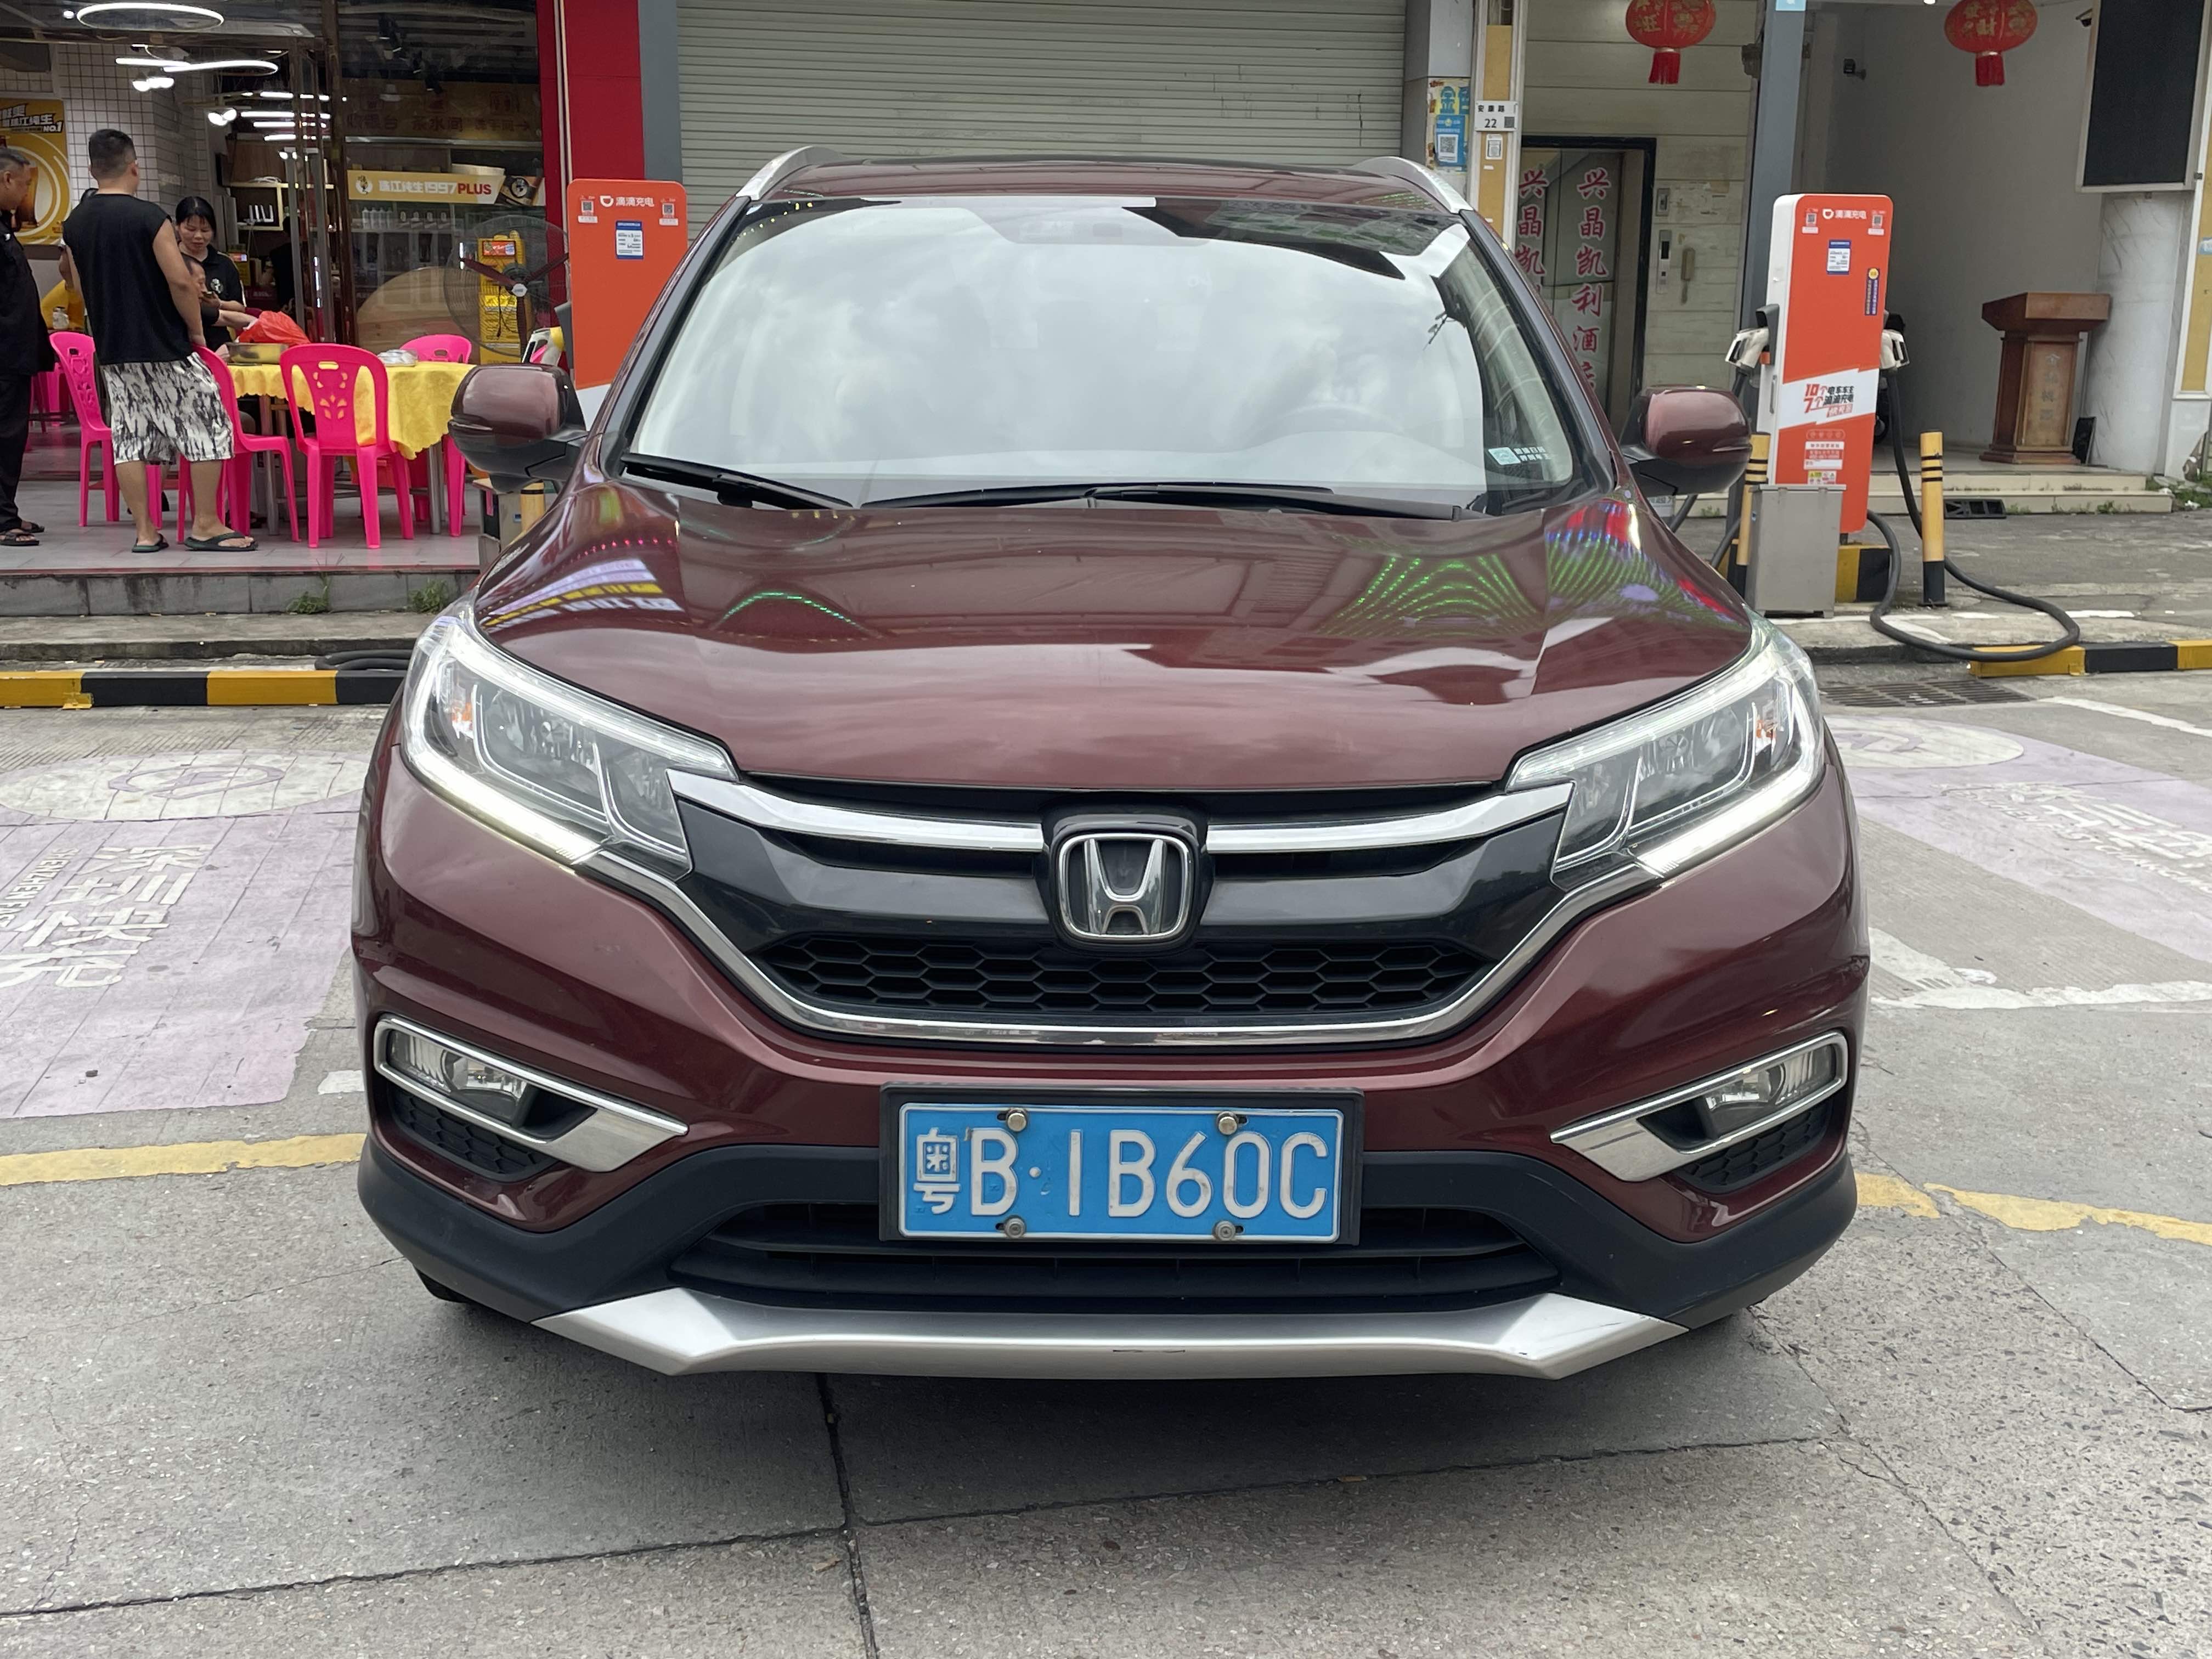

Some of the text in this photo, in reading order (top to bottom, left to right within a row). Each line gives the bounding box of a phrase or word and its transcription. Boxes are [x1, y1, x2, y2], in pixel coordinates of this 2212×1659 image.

[43, 121, 62, 132] NO.1
[1485, 119, 1497, 128] 22
[616, 196, 655, 207] 滴滴充电
[1515, 168, 1548, 295] 兴晶凯
[4, 848, 81, 900] SHENZHEN
